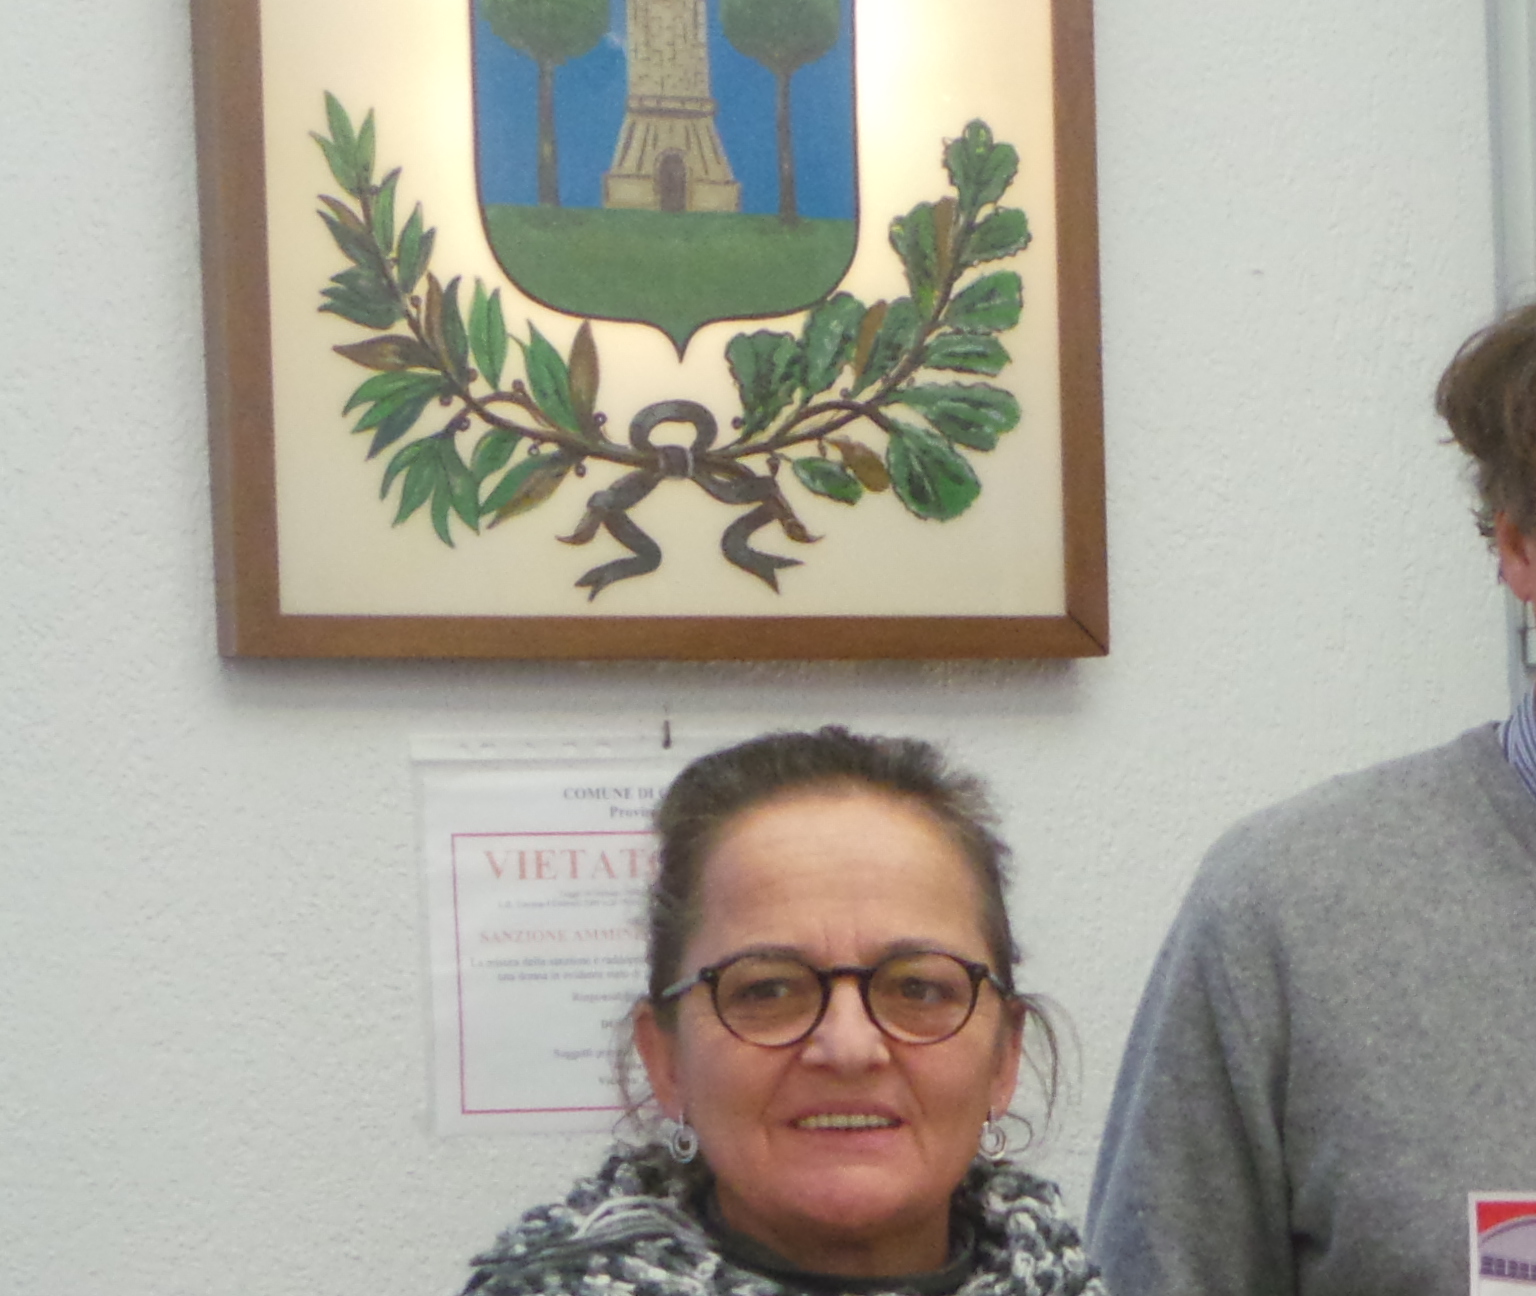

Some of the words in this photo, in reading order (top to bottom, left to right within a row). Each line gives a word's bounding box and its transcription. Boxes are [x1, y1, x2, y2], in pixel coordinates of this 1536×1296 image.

[564, 787, 633, 800] COMUNE
[638, 786, 654, 799] DI
[480, 929, 565, 944] SANZIONE
